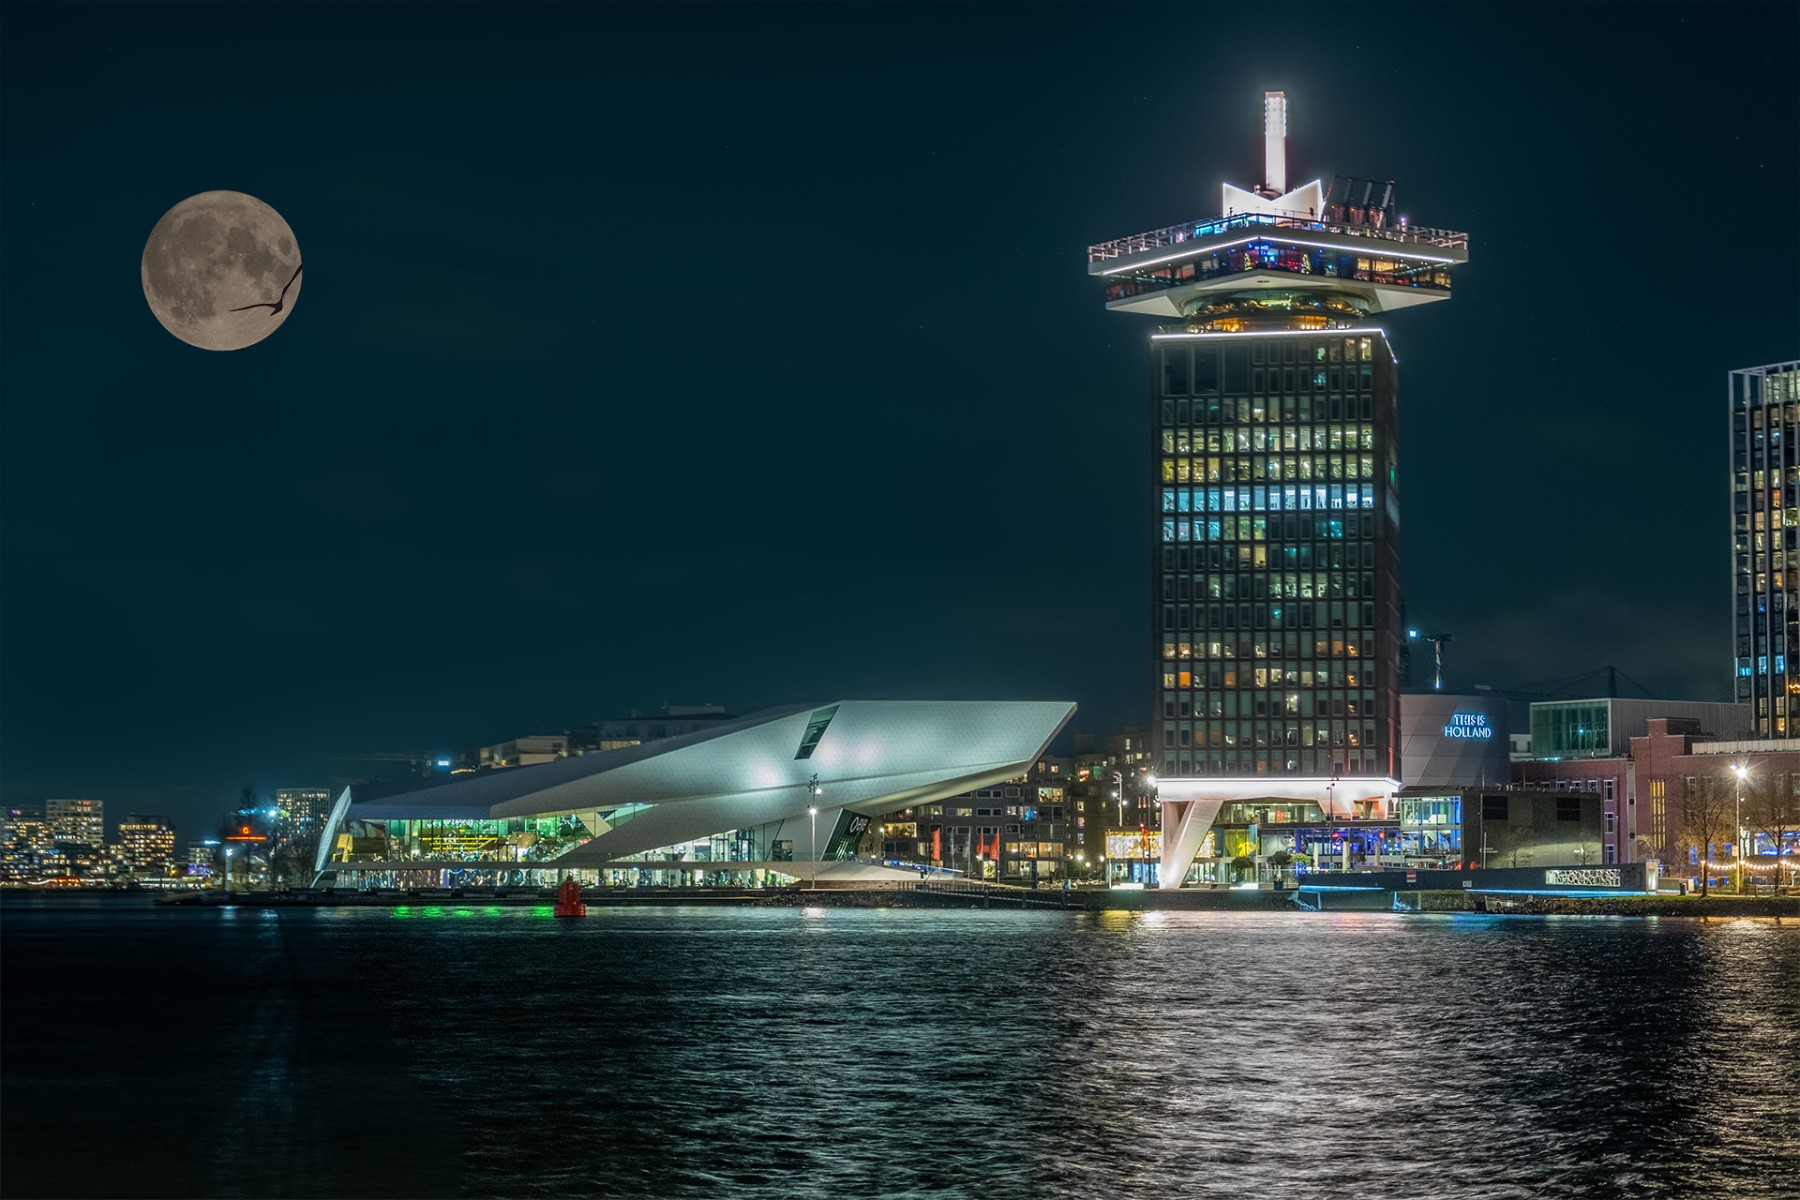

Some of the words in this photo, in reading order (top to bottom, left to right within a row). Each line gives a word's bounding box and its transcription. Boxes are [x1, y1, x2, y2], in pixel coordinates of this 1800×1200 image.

[1454, 714, 1476, 726] THIS
[1476, 714, 1485, 726] IS
[1444, 726, 1491, 737] HOLLAND
